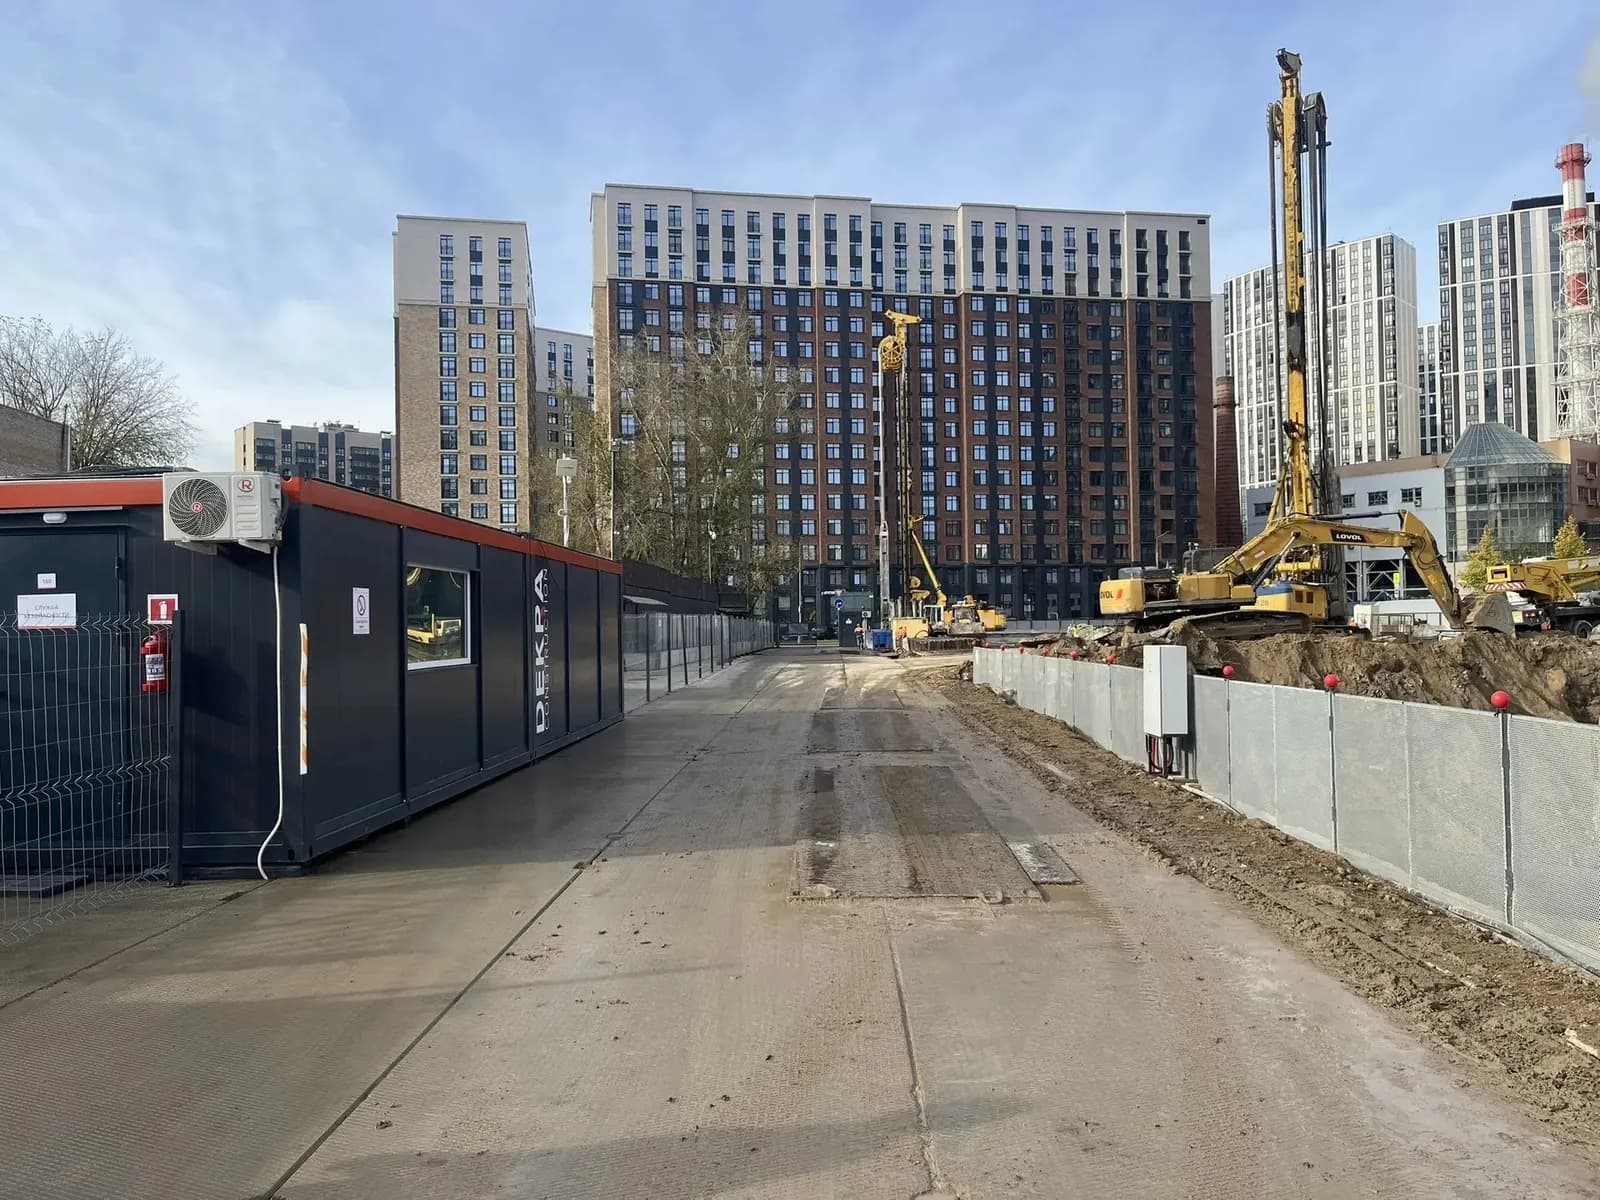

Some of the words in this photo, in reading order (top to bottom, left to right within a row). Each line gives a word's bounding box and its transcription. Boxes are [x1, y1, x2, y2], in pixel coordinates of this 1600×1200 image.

[242, 479, 252, 489] R
[1336, 533, 1362, 541] LOVOL
[535, 568, 545, 734] DEKRA
